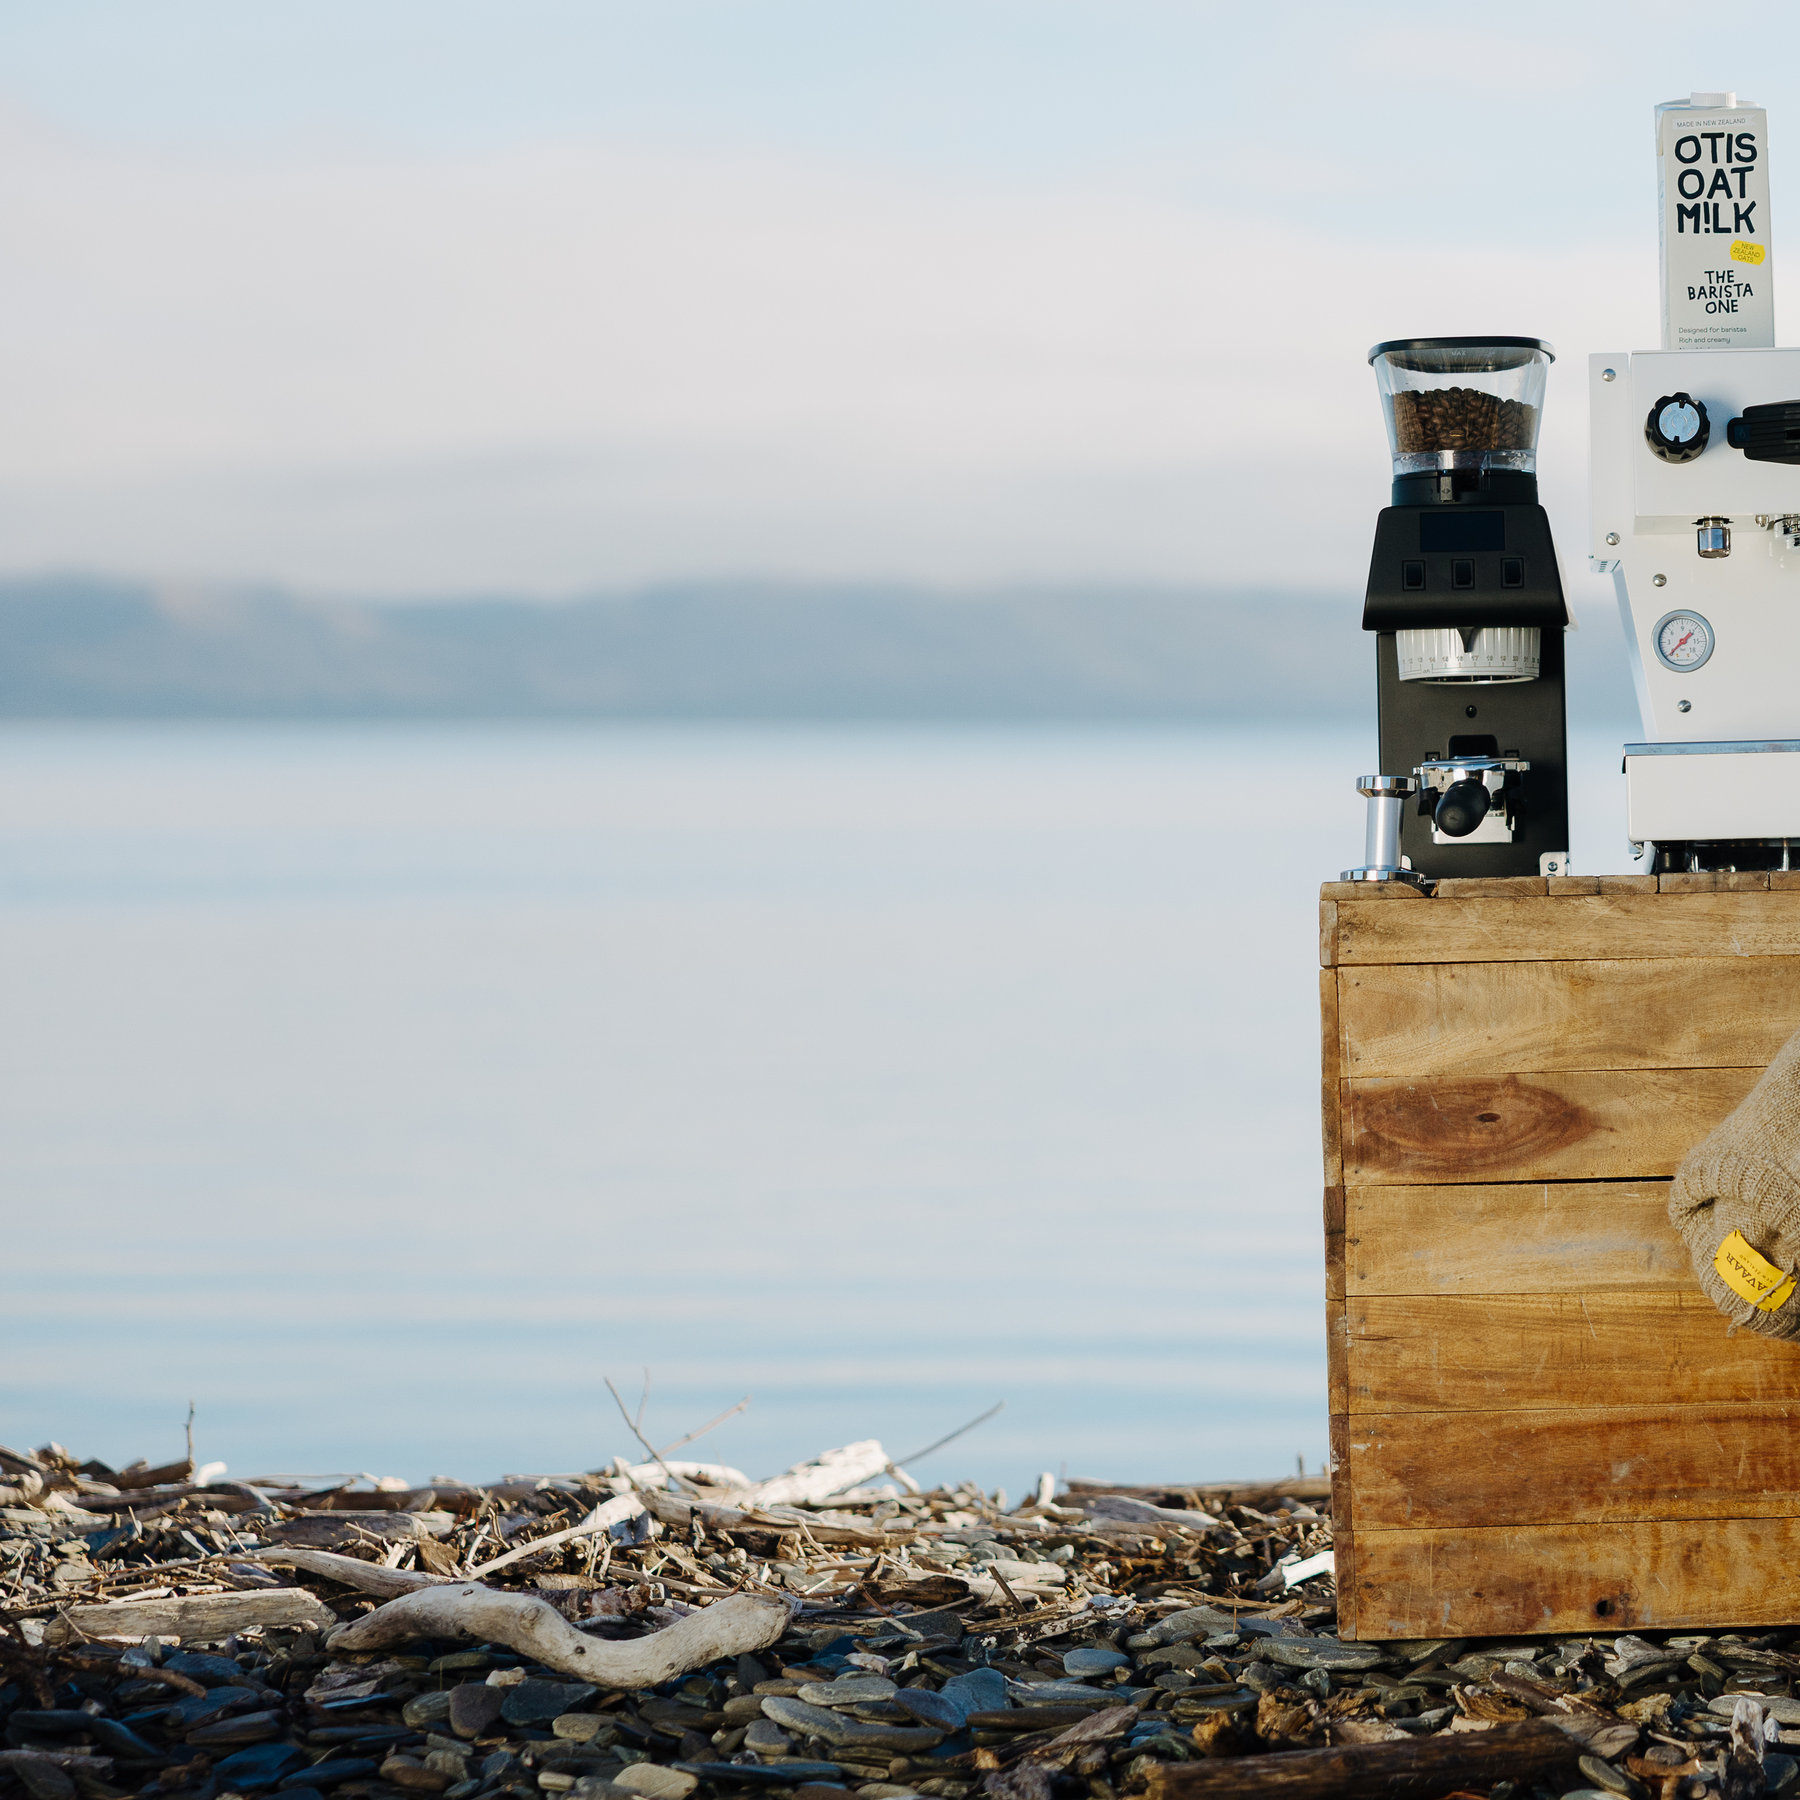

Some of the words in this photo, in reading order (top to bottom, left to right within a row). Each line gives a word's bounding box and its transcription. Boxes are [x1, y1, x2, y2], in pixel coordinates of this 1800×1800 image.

[1718, 117, 1746, 126] ZEALAND
[1674, 132, 1758, 164] OTIS
[1677, 166, 1755, 200] OAT
[1676, 200, 1756, 234] M!LK
[1733, 247, 1761, 258] ZEALAND
[1741, 242, 1755, 250] NEW
[1737, 254, 1754, 263] OATS
[1704, 269, 1735, 284] THE
[1687, 283, 1754, 301] BARISTA
[1705, 299, 1739, 314] ONE
[1678, 326, 1708, 335] Designed
[1706, 336, 1731, 344] creamy
